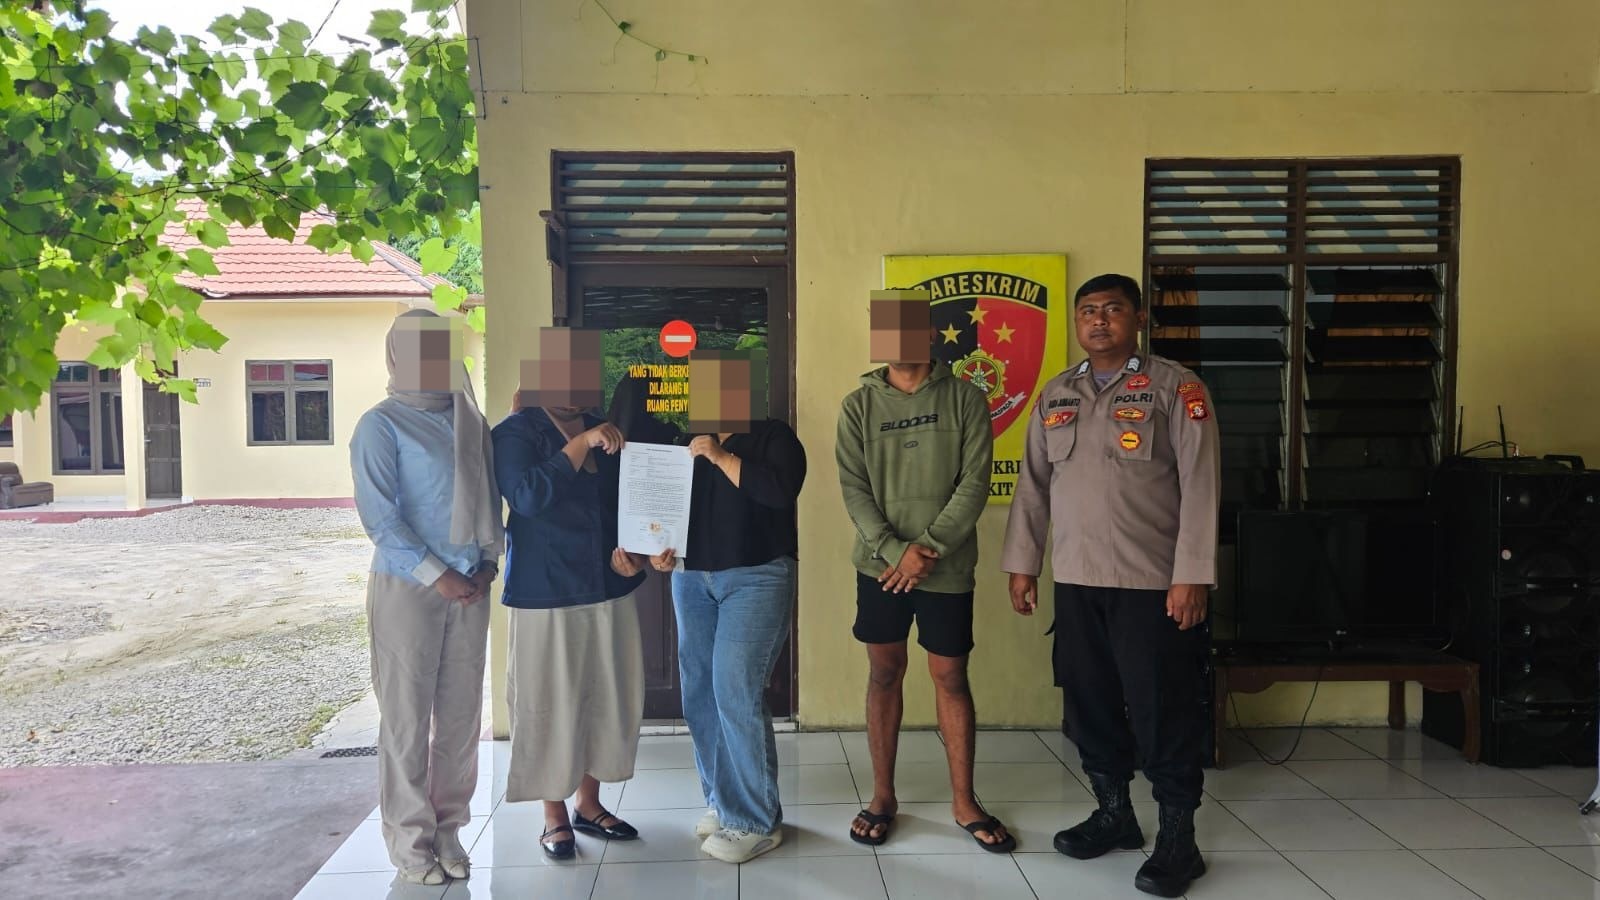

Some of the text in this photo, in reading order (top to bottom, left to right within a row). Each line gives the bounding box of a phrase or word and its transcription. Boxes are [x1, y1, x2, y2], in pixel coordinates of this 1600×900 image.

[914, 274, 1041, 303] ARESKRIM
[629, 364, 647, 378] YANG
[648, 364, 668, 378] TIDAK
[649, 382, 681, 395] DILARANG
[646, 399, 669, 412] RUANG
[1114, 393, 1153, 405] POLRI
